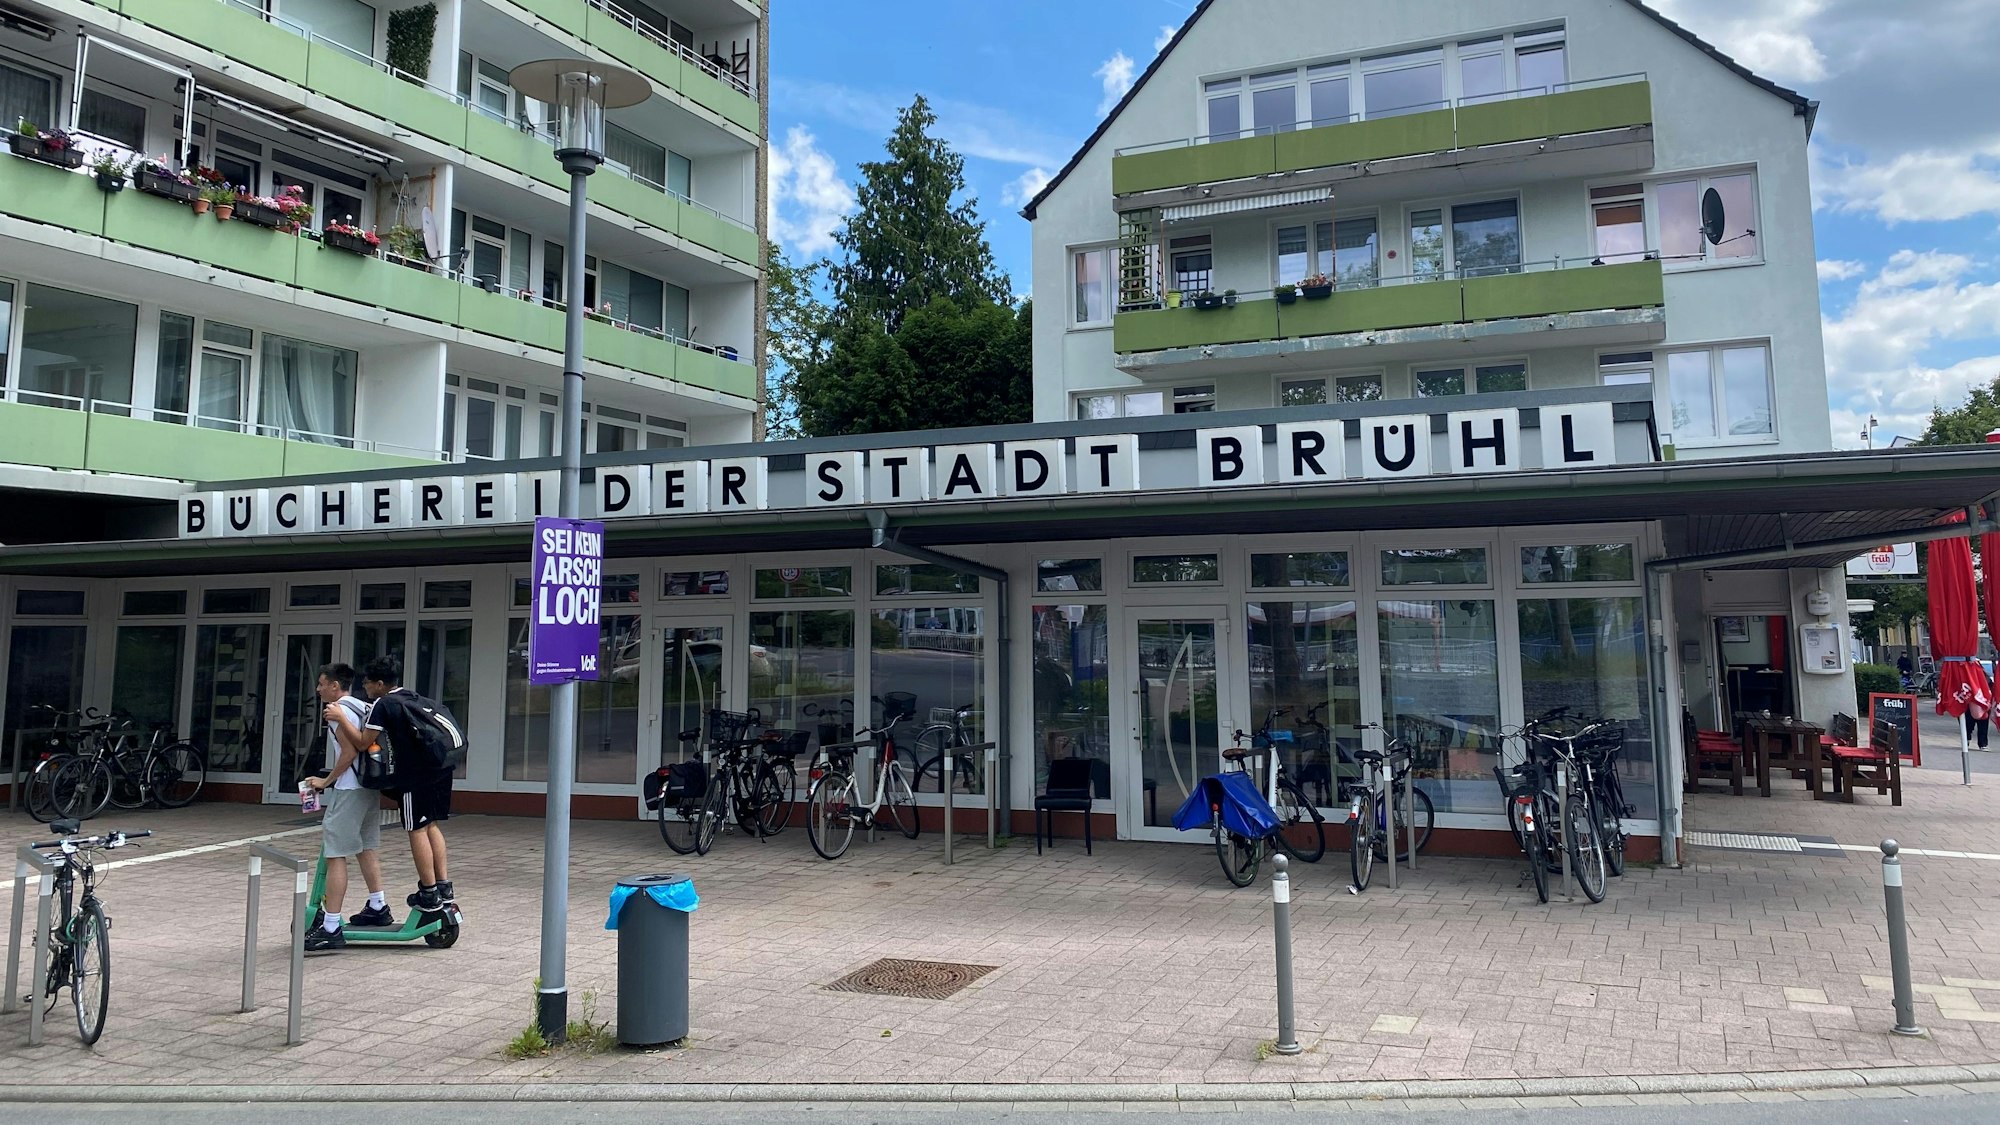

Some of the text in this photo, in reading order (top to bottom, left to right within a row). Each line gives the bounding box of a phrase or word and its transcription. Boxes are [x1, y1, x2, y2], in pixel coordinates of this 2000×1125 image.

[186, 413, 1594, 534] BÜCHEREI DER STADT BRÜHL
[542, 528, 600, 557] SEI KEIN
[540, 556, 601, 586] ARSCH
[1871, 553, 1891, 564] früh
[538, 586, 600, 625] LOCH
[580, 655, 596, 671] Volt
[1882, 698, 1904, 709] früh
